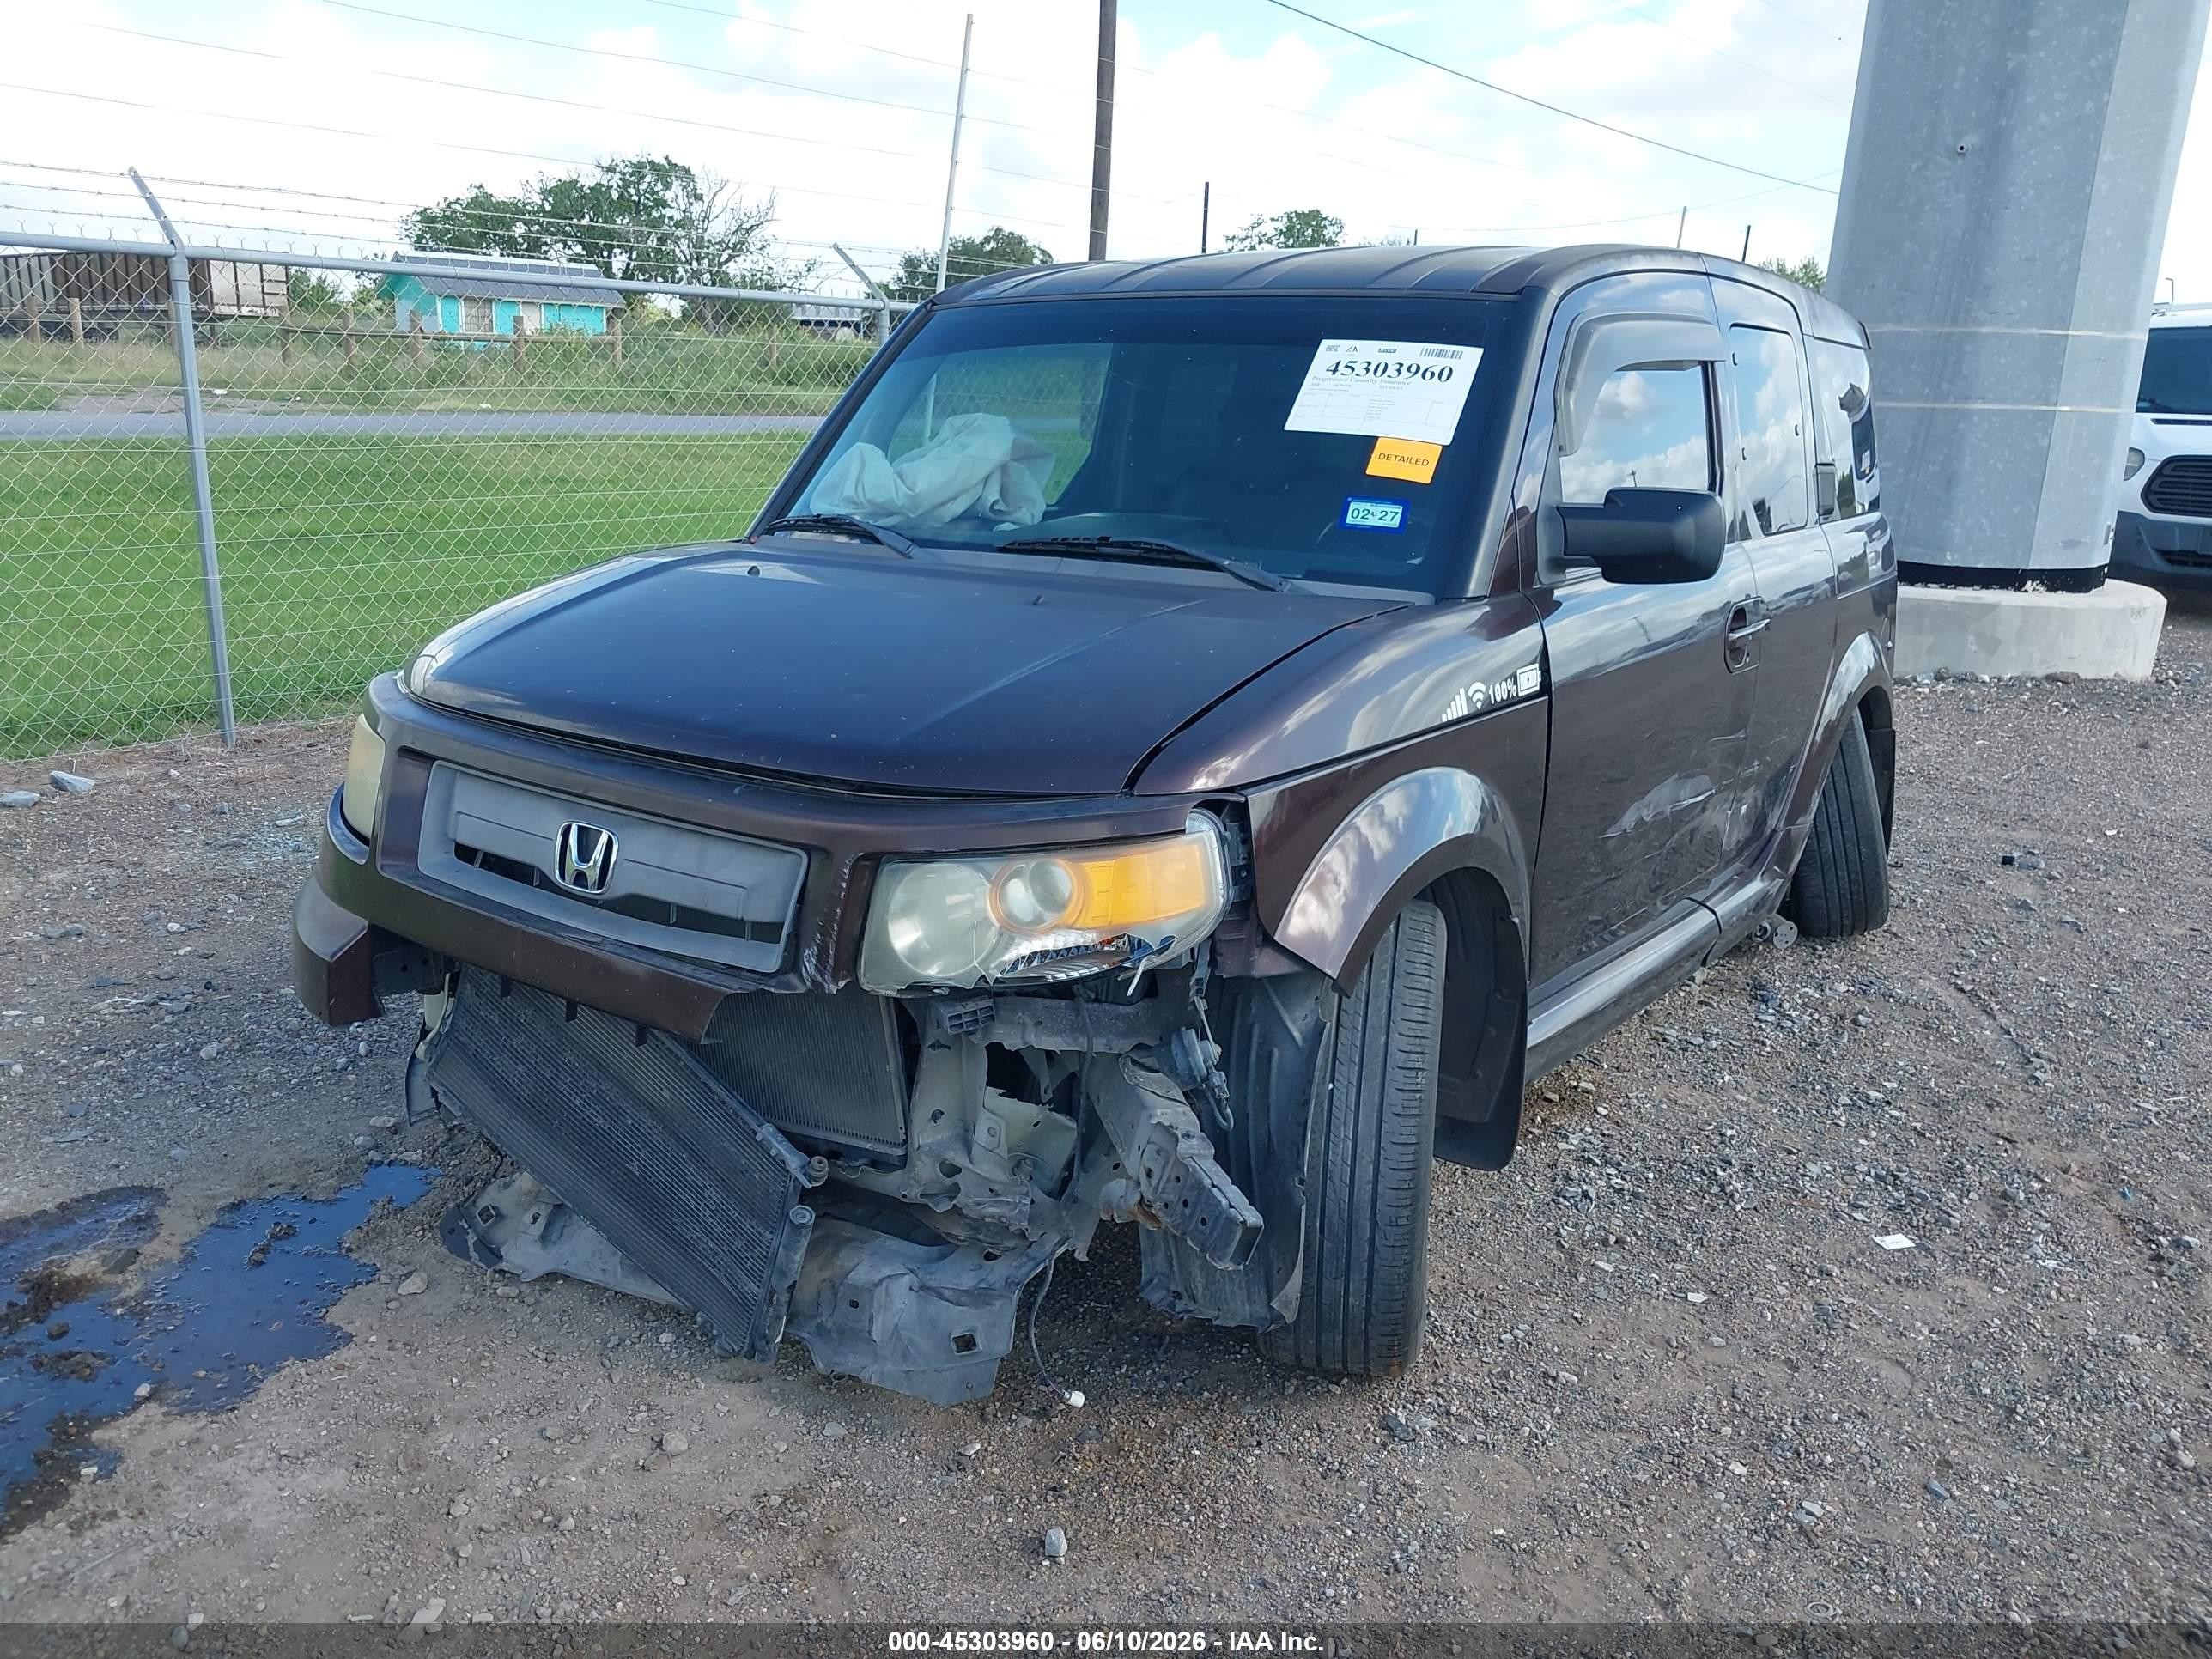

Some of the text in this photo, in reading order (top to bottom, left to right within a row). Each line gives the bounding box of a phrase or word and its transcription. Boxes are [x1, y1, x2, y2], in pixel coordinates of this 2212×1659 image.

[1326, 359, 1453, 383] 45303960
[1377, 452, 1430, 467] DETAILED
[1351, 507, 1400, 522] 02 27
[1488, 677, 1517, 705] 100%
